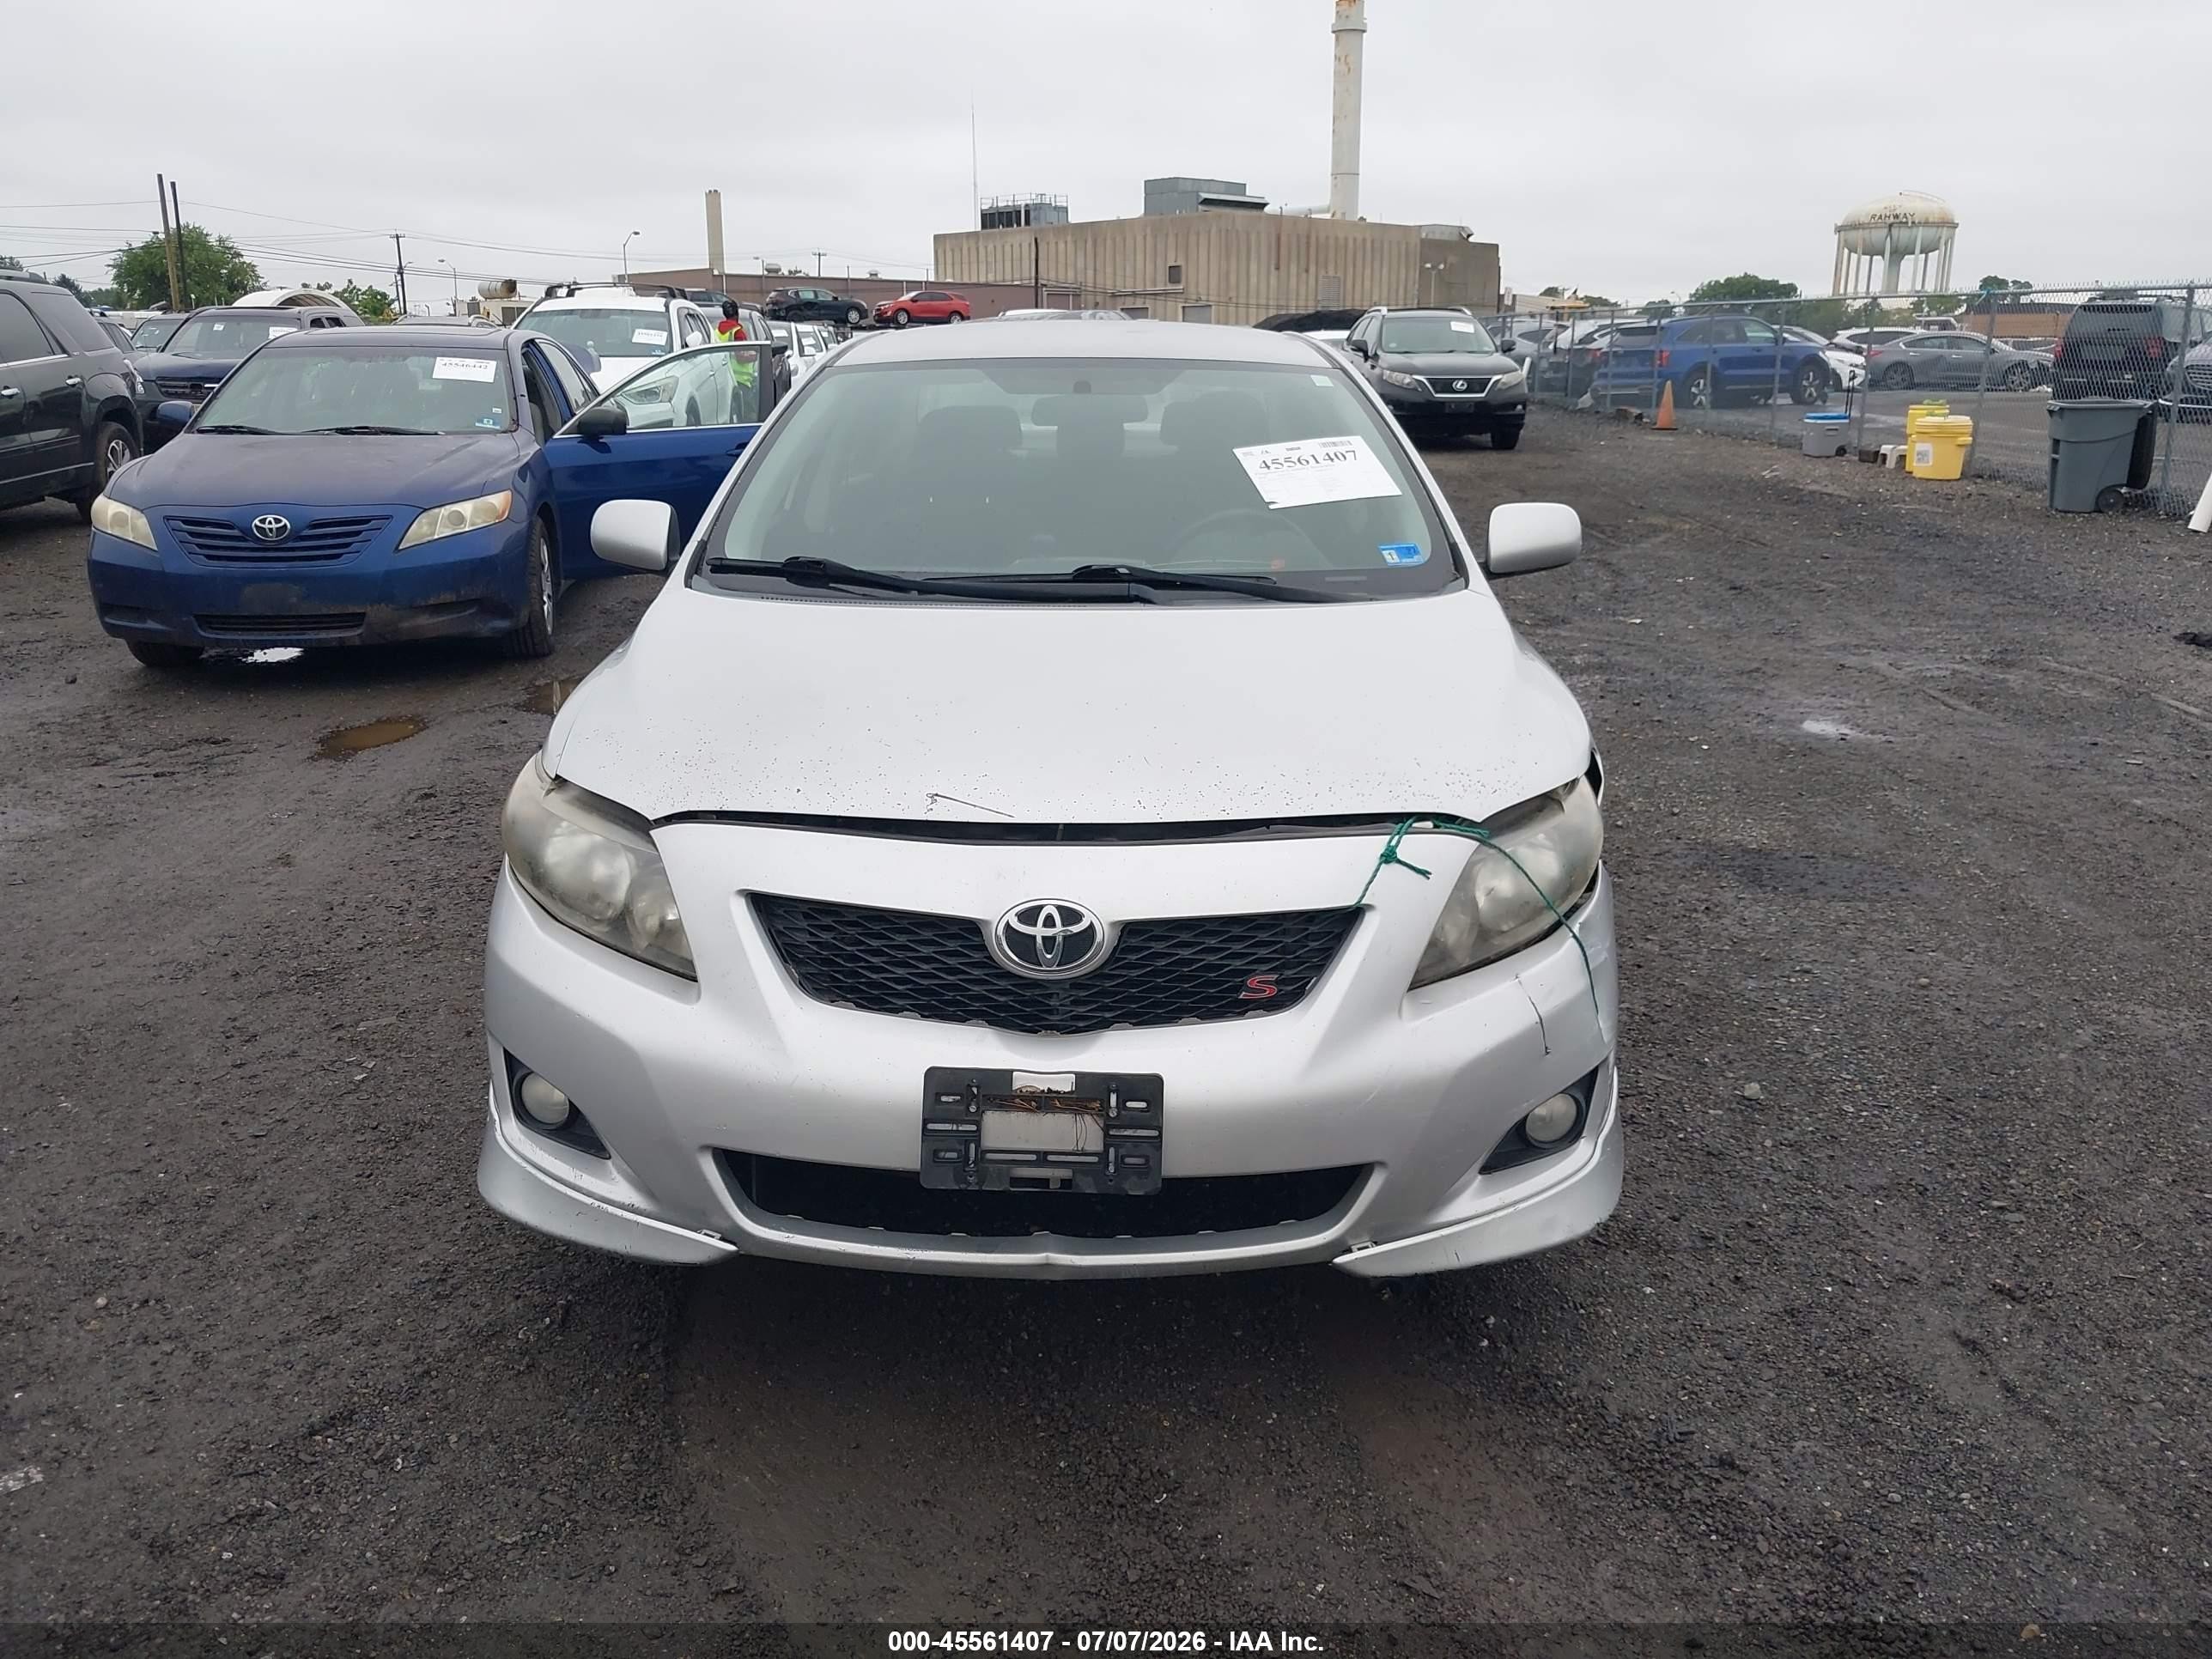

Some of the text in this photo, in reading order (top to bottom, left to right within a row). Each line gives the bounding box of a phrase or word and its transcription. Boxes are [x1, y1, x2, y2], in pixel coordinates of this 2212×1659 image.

[1869, 212, 1916, 222] RAHWAY
[1258, 449, 1358, 471] 45561407
[1237, 974, 1280, 1000] S
